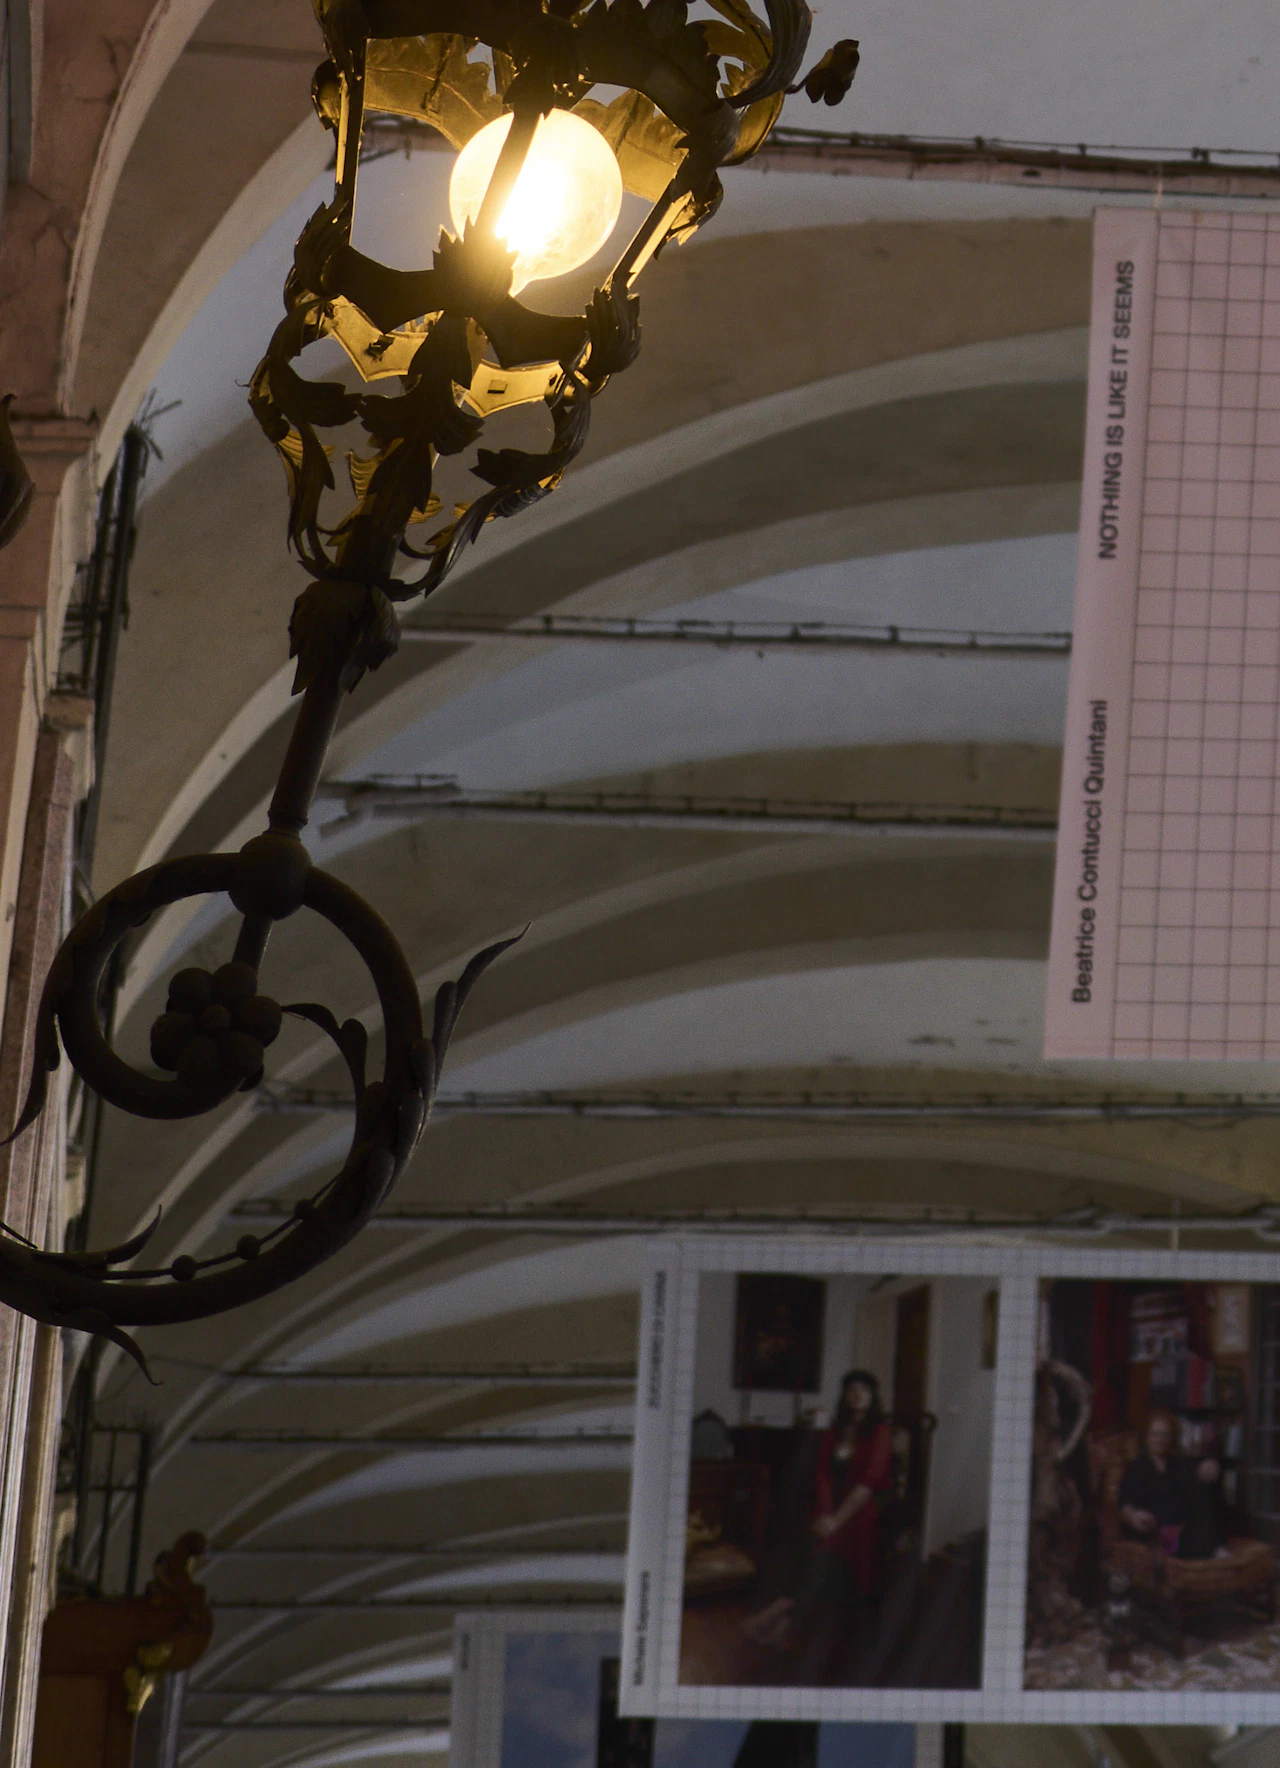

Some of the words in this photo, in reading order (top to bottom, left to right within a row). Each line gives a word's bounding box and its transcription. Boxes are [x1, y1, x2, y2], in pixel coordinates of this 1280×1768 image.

[1113, 260, 1135, 340] SEEMS
[1108, 368, 1128, 420] LIKE
[1111, 344, 1128, 364] IT
[1106, 424, 1125, 447] IS
[1098, 452, 1122, 560] NOTHING
[1084, 699, 1108, 795] Quintani
[1077, 799, 1102, 902] Contucci
[1071, 907, 1097, 1004] Beatrice
